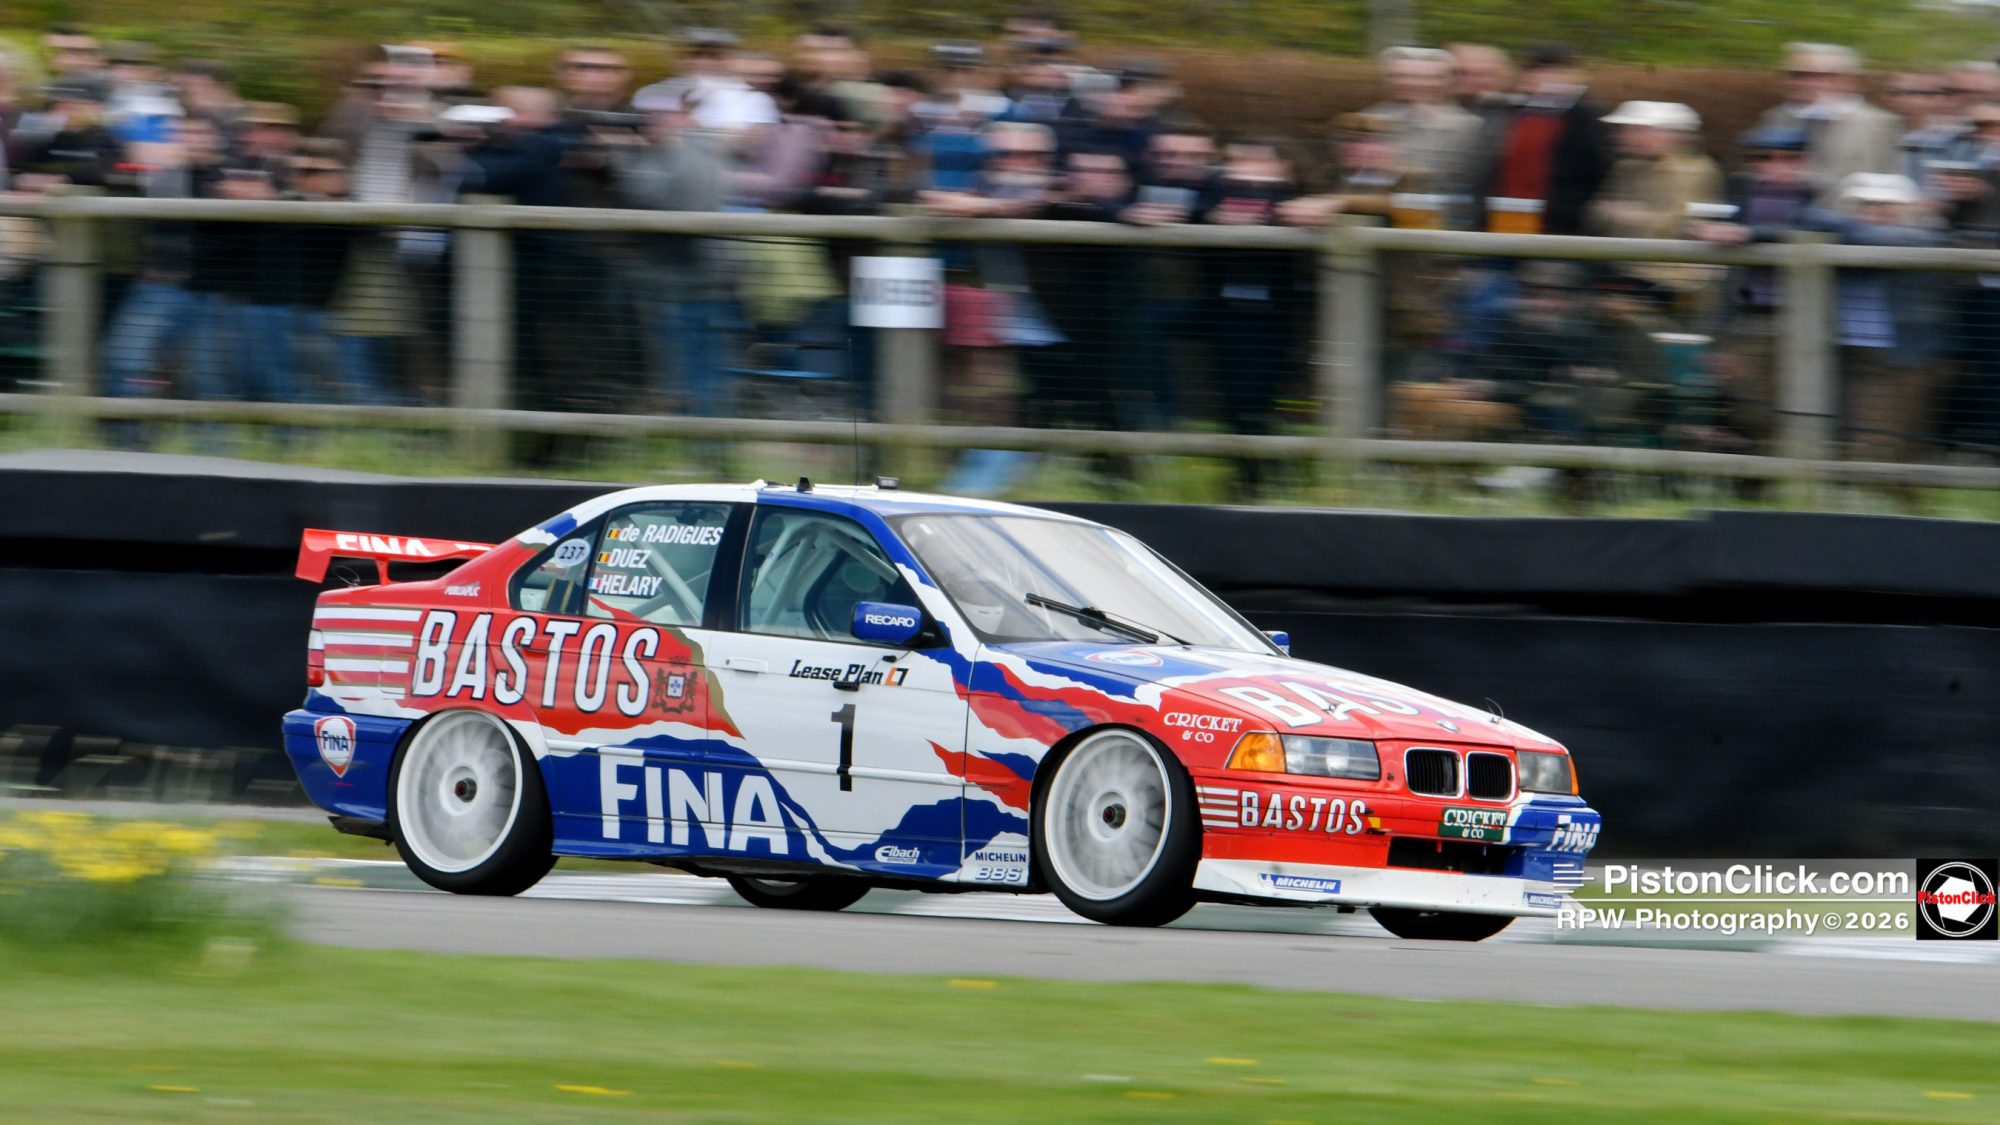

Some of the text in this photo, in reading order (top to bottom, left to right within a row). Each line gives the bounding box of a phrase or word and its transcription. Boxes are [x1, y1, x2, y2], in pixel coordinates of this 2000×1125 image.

[619, 523, 724, 546] de RADIGUES
[559, 545, 586, 561] 237
[608, 548, 653, 569] DUEZ
[598, 574, 662, 596] HELARY
[865, 613, 916, 628] RECARO
[411, 608, 660, 717] BASTOS
[789, 659, 884, 685] Lease Plan
[1163, 711, 1243, 733] CRICKET
[322, 730, 349, 752] FINA
[831, 703, 856, 792] 1
[1182, 730, 1215, 743] & CO
[599, 746, 789, 855] FINA
[1240, 790, 1367, 835] BASTOS
[1444, 809, 1506, 831] CRICKET
[1471, 828, 1484, 839] CO
[1546, 815, 1600, 853] FINA
[875, 845, 920, 864] Eibach
[975, 852, 1027, 863] MICHELIN
[975, 866, 1022, 881] BBS
[1276, 877, 1337, 890] MICHELIN
